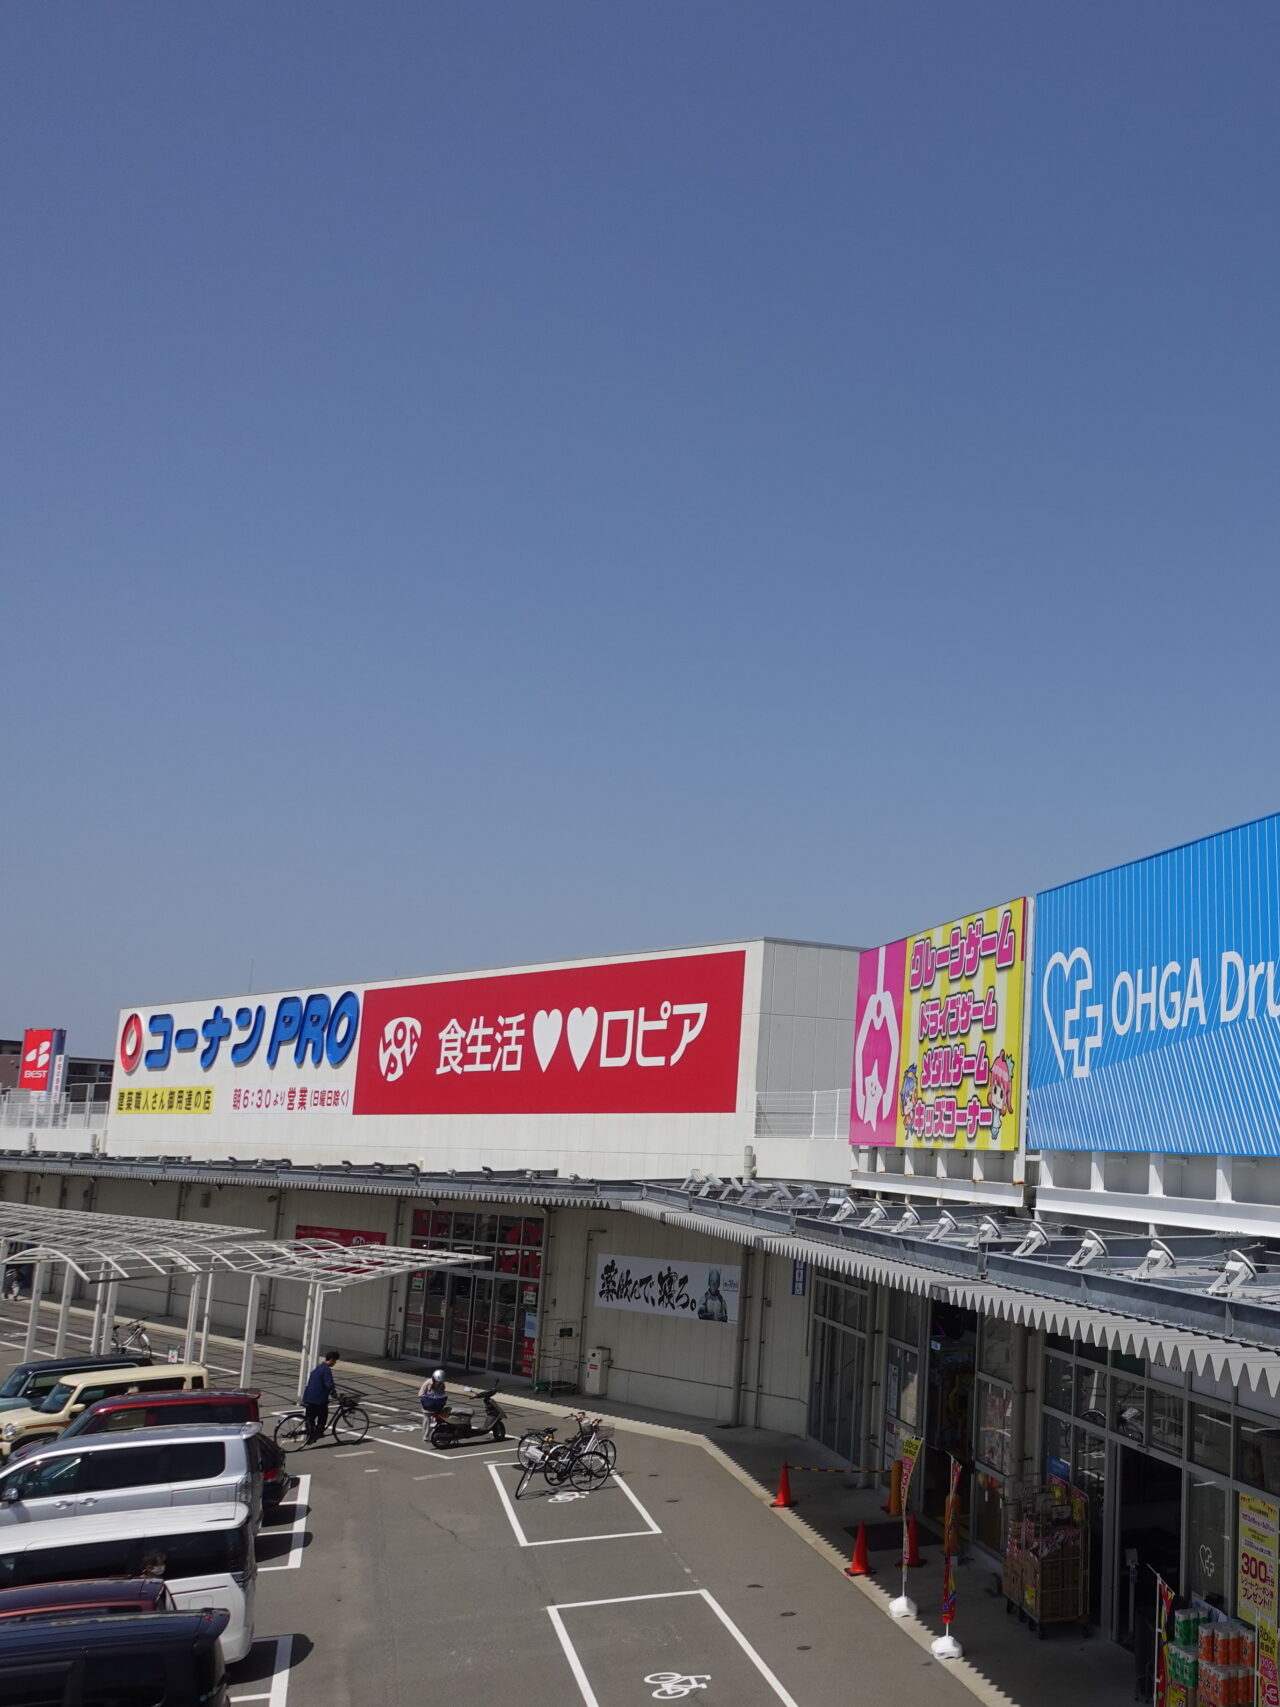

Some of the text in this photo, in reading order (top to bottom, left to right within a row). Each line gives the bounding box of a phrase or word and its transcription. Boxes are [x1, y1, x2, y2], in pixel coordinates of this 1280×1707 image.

[910, 910, 1014, 990] クレーンゲーム
[918, 988, 997, 1040] ドライブゲーム
[1112, 957, 1207, 1037] OHGA
[144, 990, 360, 1070] コーナン PRO
[436, 1001, 708, 1075] 食生活 ロピア
[24, 1070, 48, 1078] BEST
[920, 1042, 989, 1089] メダルゲーム
[913, 1095, 993, 1140] キッズコーナー
